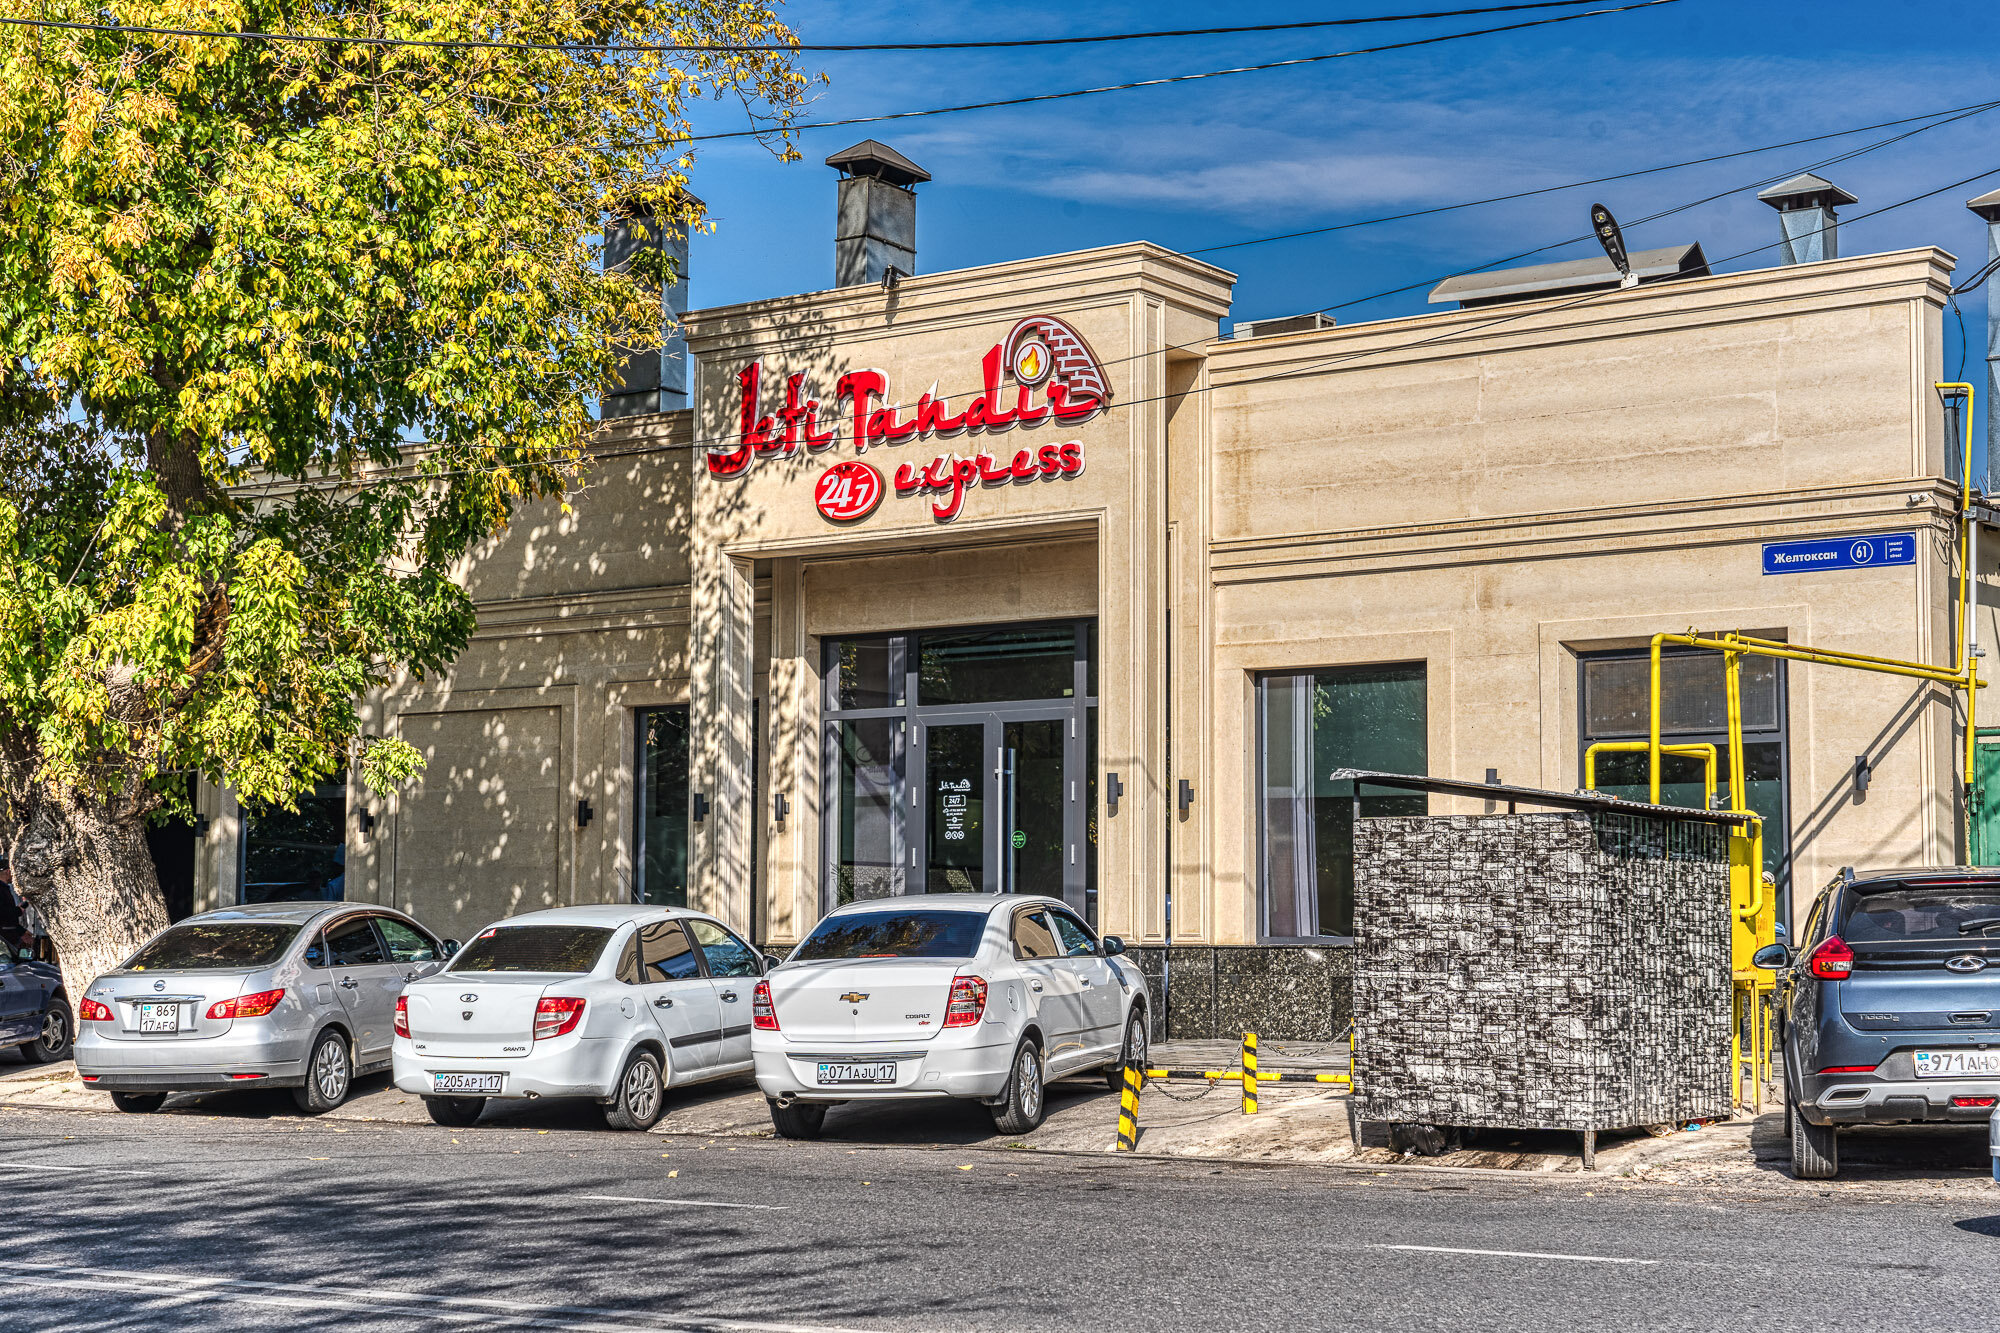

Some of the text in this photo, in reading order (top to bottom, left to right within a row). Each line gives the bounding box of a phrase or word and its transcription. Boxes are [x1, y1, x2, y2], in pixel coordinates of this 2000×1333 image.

[707, 340, 1106, 479] Jeti Tandir
[894, 439, 1086, 522] express
[1774, 545, 1867, 564] Желтоксан 61
[156, 1005, 177, 1018] 869
[143, 1020, 155, 1032] 17
[879, 1064, 895, 1079] 17
[1917, 1063, 1930, 1072] KZ
[487, 1075, 501, 1088] 17
